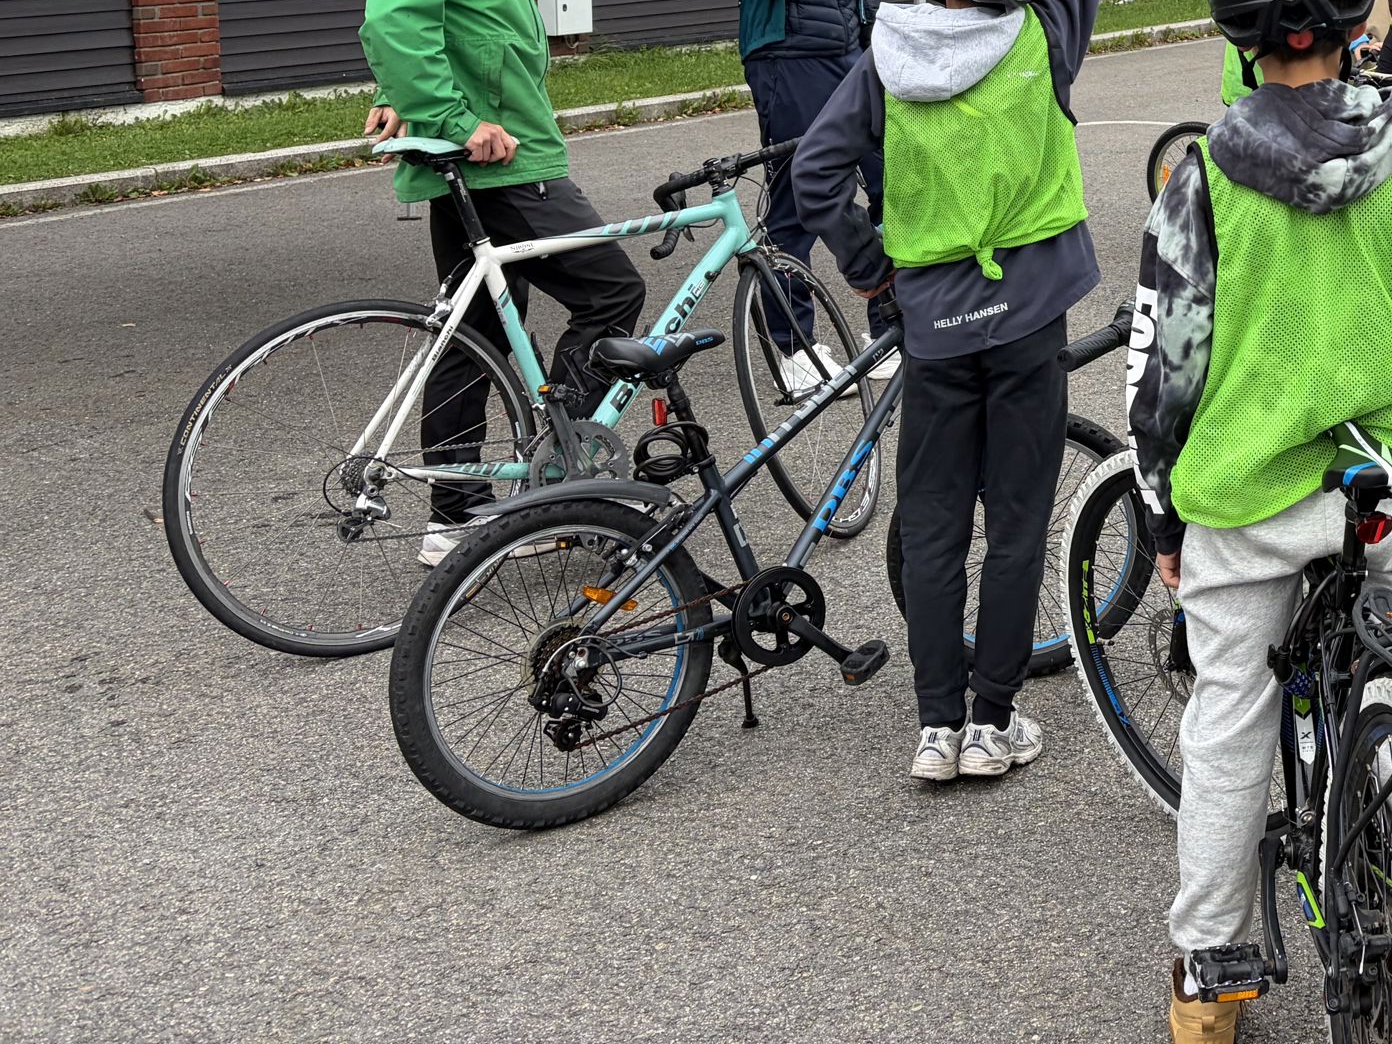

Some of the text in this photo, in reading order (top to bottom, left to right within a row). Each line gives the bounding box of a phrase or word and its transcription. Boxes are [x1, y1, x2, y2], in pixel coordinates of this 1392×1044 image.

[933, 301, 1009, 330] HELLY HANSEN
[180, 371, 227, 446] CONTINENTAL
[811, 438, 874, 533] DBS
